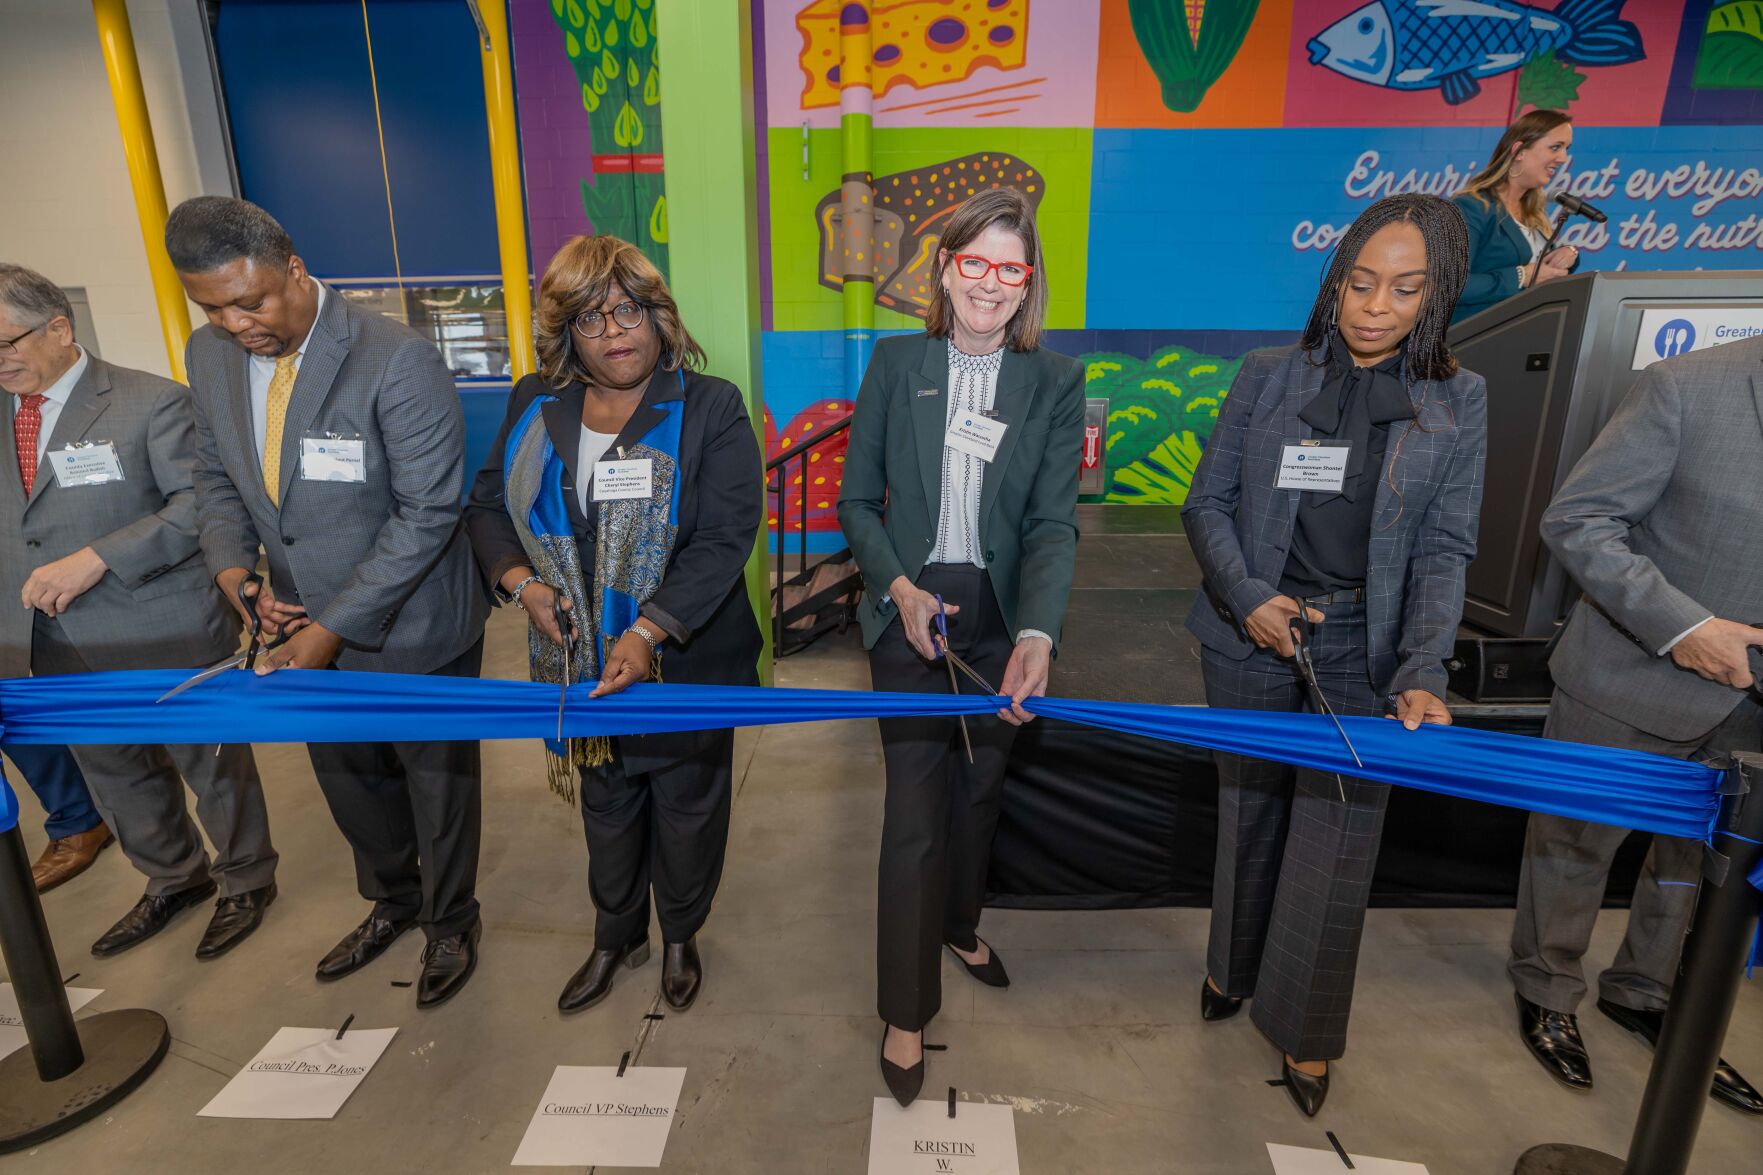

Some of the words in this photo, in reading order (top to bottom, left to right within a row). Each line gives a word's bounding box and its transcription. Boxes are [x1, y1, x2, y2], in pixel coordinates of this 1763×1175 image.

[1343, 150, 1478, 199] Ensuri
[1546, 153, 1620, 201] hat
[1624, 159, 1763, 218] everyo
[1619, 209, 1679, 251] the
[250, 1059, 296, 1072] Council
[295, 1061, 321, 1073] Pres.
[544, 1102, 592, 1114] Council
[595, 1103, 614, 1114] VP
[615, 1103, 670, 1117] Stephens
[913, 1140, 976, 1155] KRISTIN
[936, 1158, 953, 1172] W.
